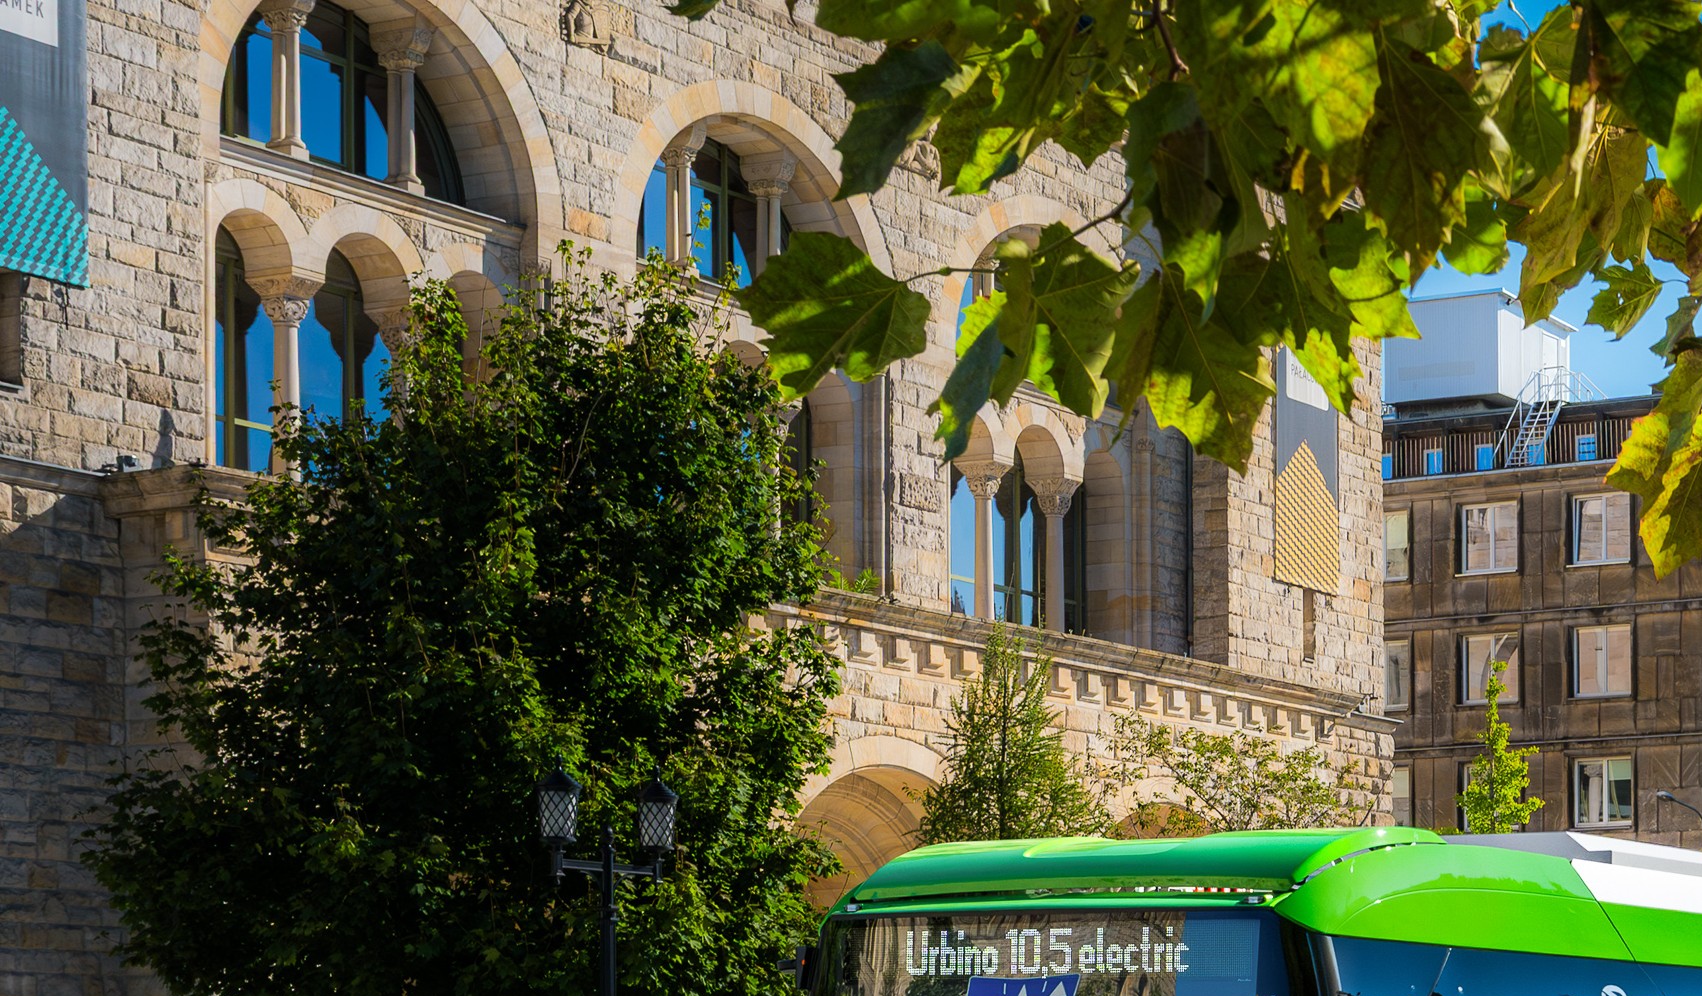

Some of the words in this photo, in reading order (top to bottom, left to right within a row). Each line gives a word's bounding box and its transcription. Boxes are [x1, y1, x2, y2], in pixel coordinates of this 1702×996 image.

[906, 930, 998, 976] Urbino
[1005, 928, 1072, 979] 10,5
[1078, 926, 1190, 973] electric
